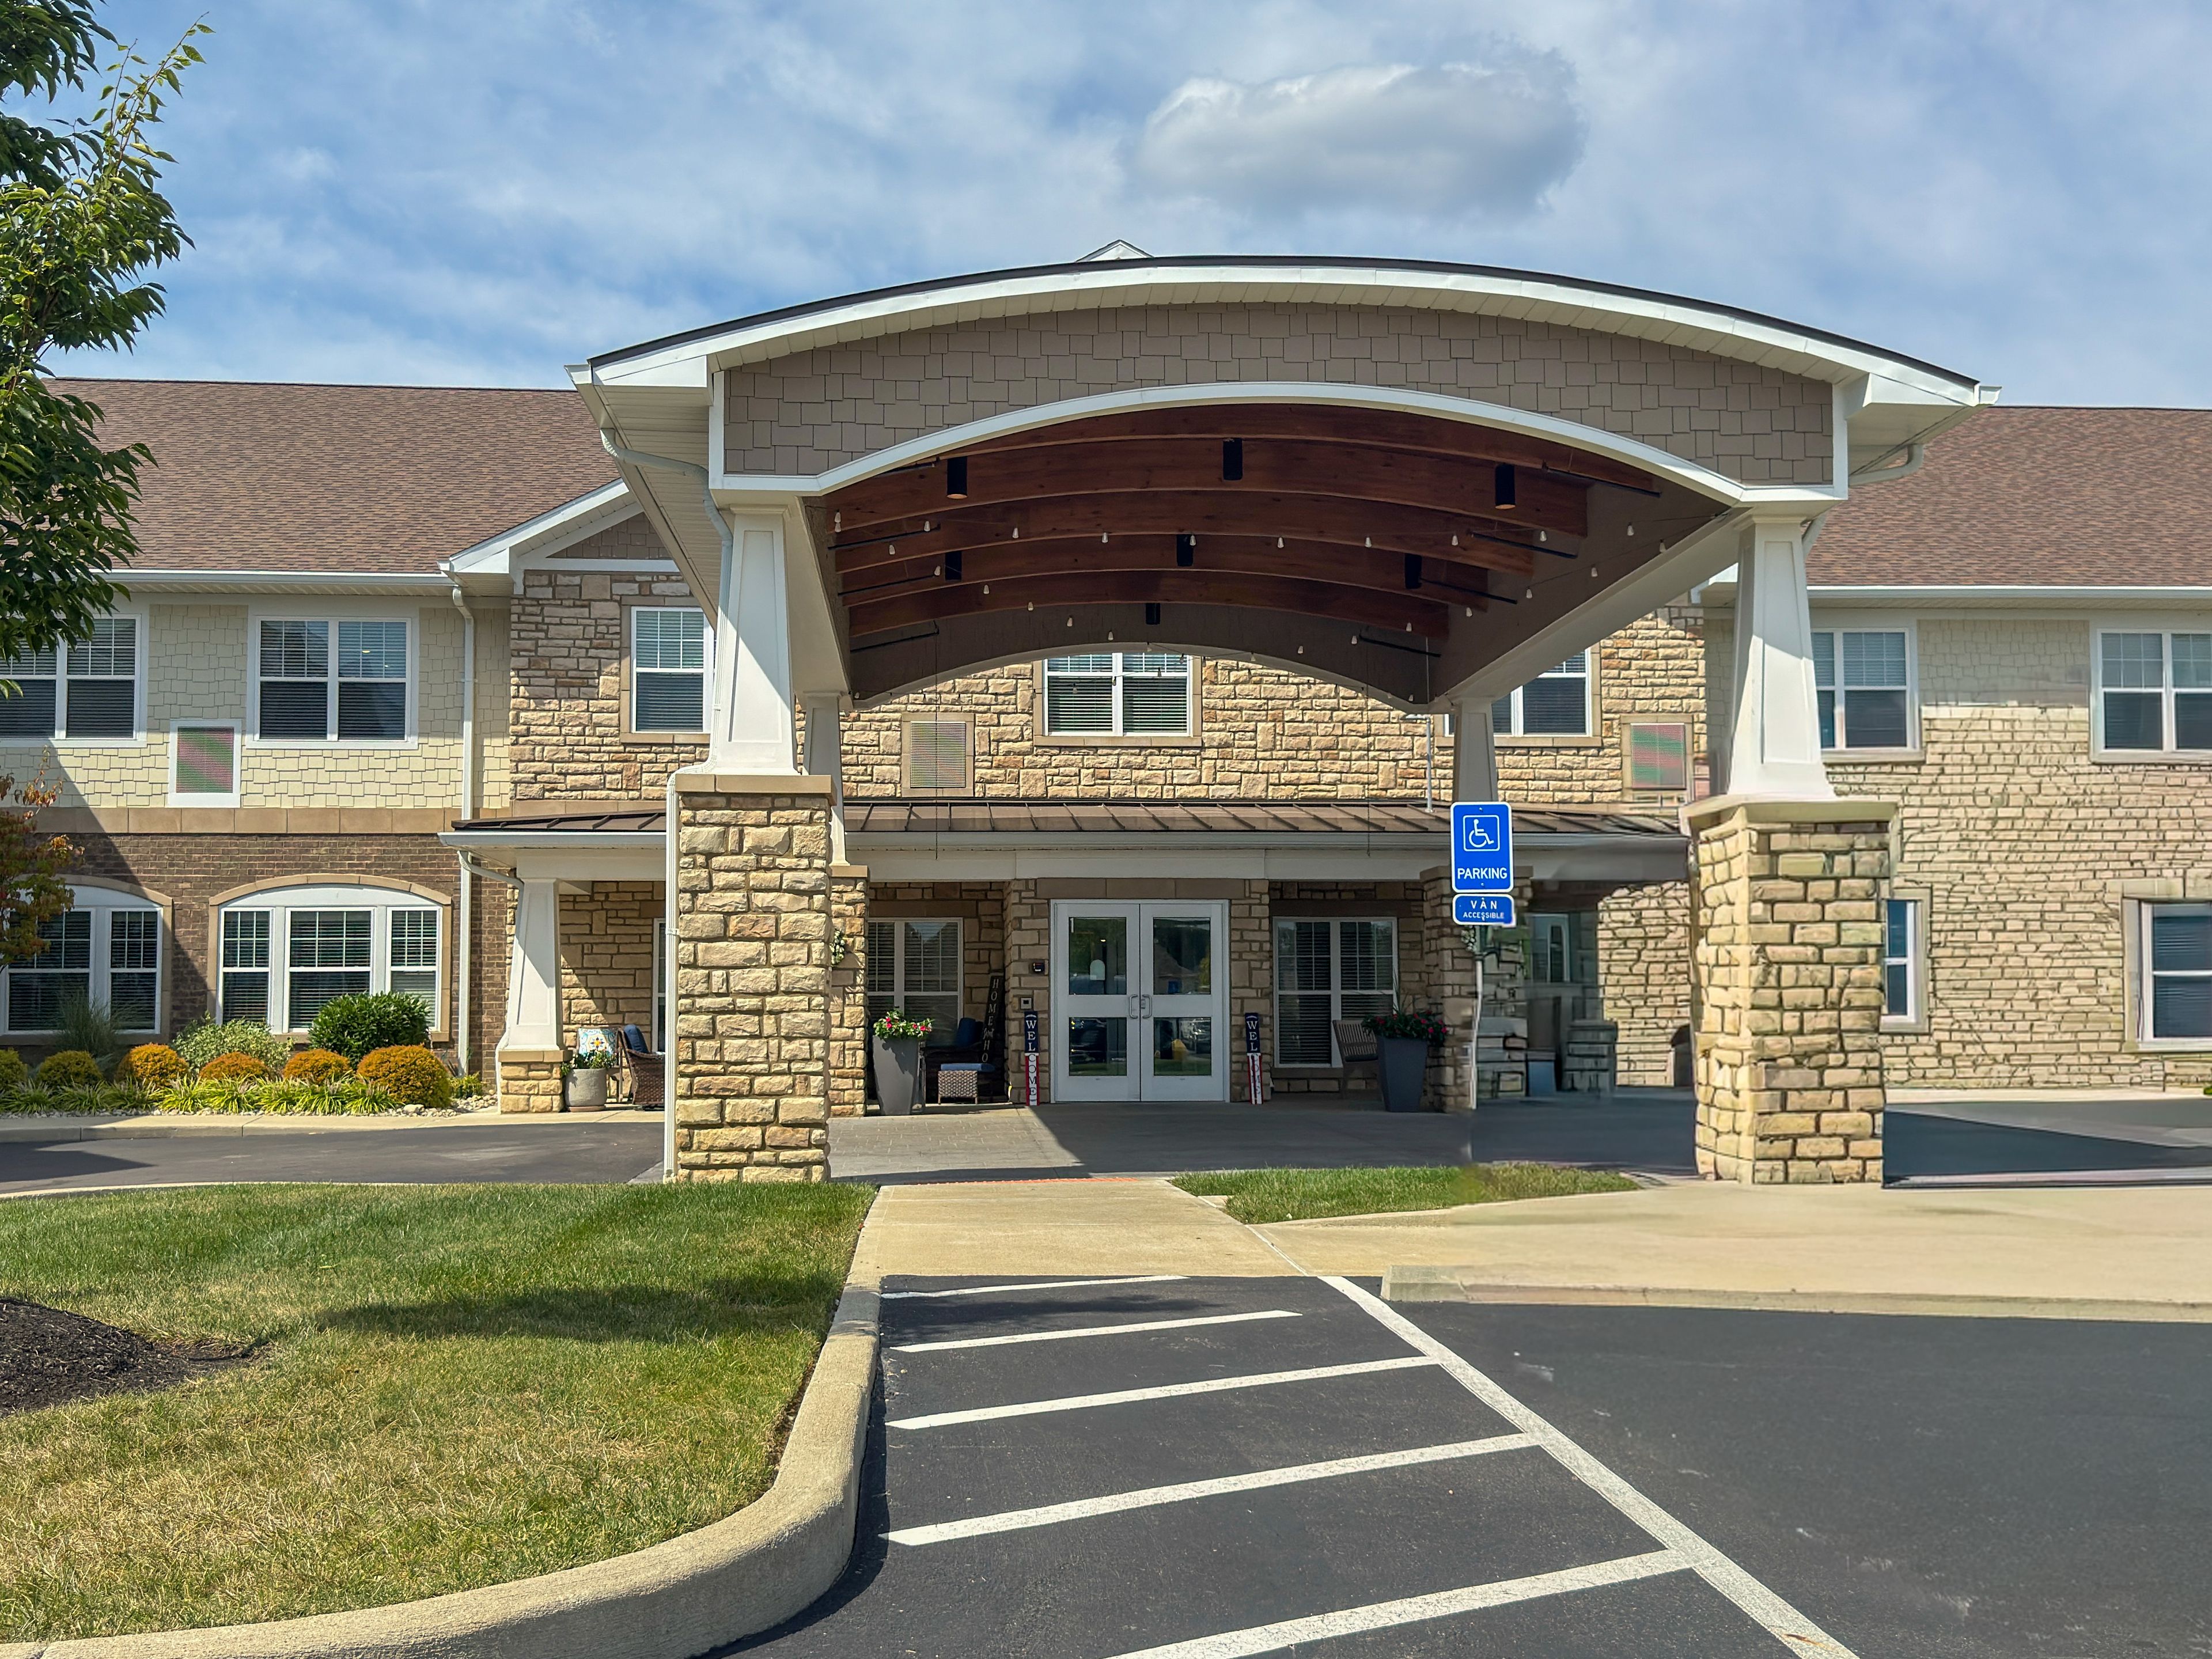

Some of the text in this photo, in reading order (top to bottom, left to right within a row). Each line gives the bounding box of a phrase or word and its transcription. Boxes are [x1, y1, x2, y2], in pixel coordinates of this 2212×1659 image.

[1457, 868, 1508, 880] PARKING
[1471, 900, 1497, 910] VAN
[988, 979, 999, 1026] HOME
[1026, 1020, 1037, 1096] WELCOME
[1246, 1021, 1261, 1094] WELCOME
